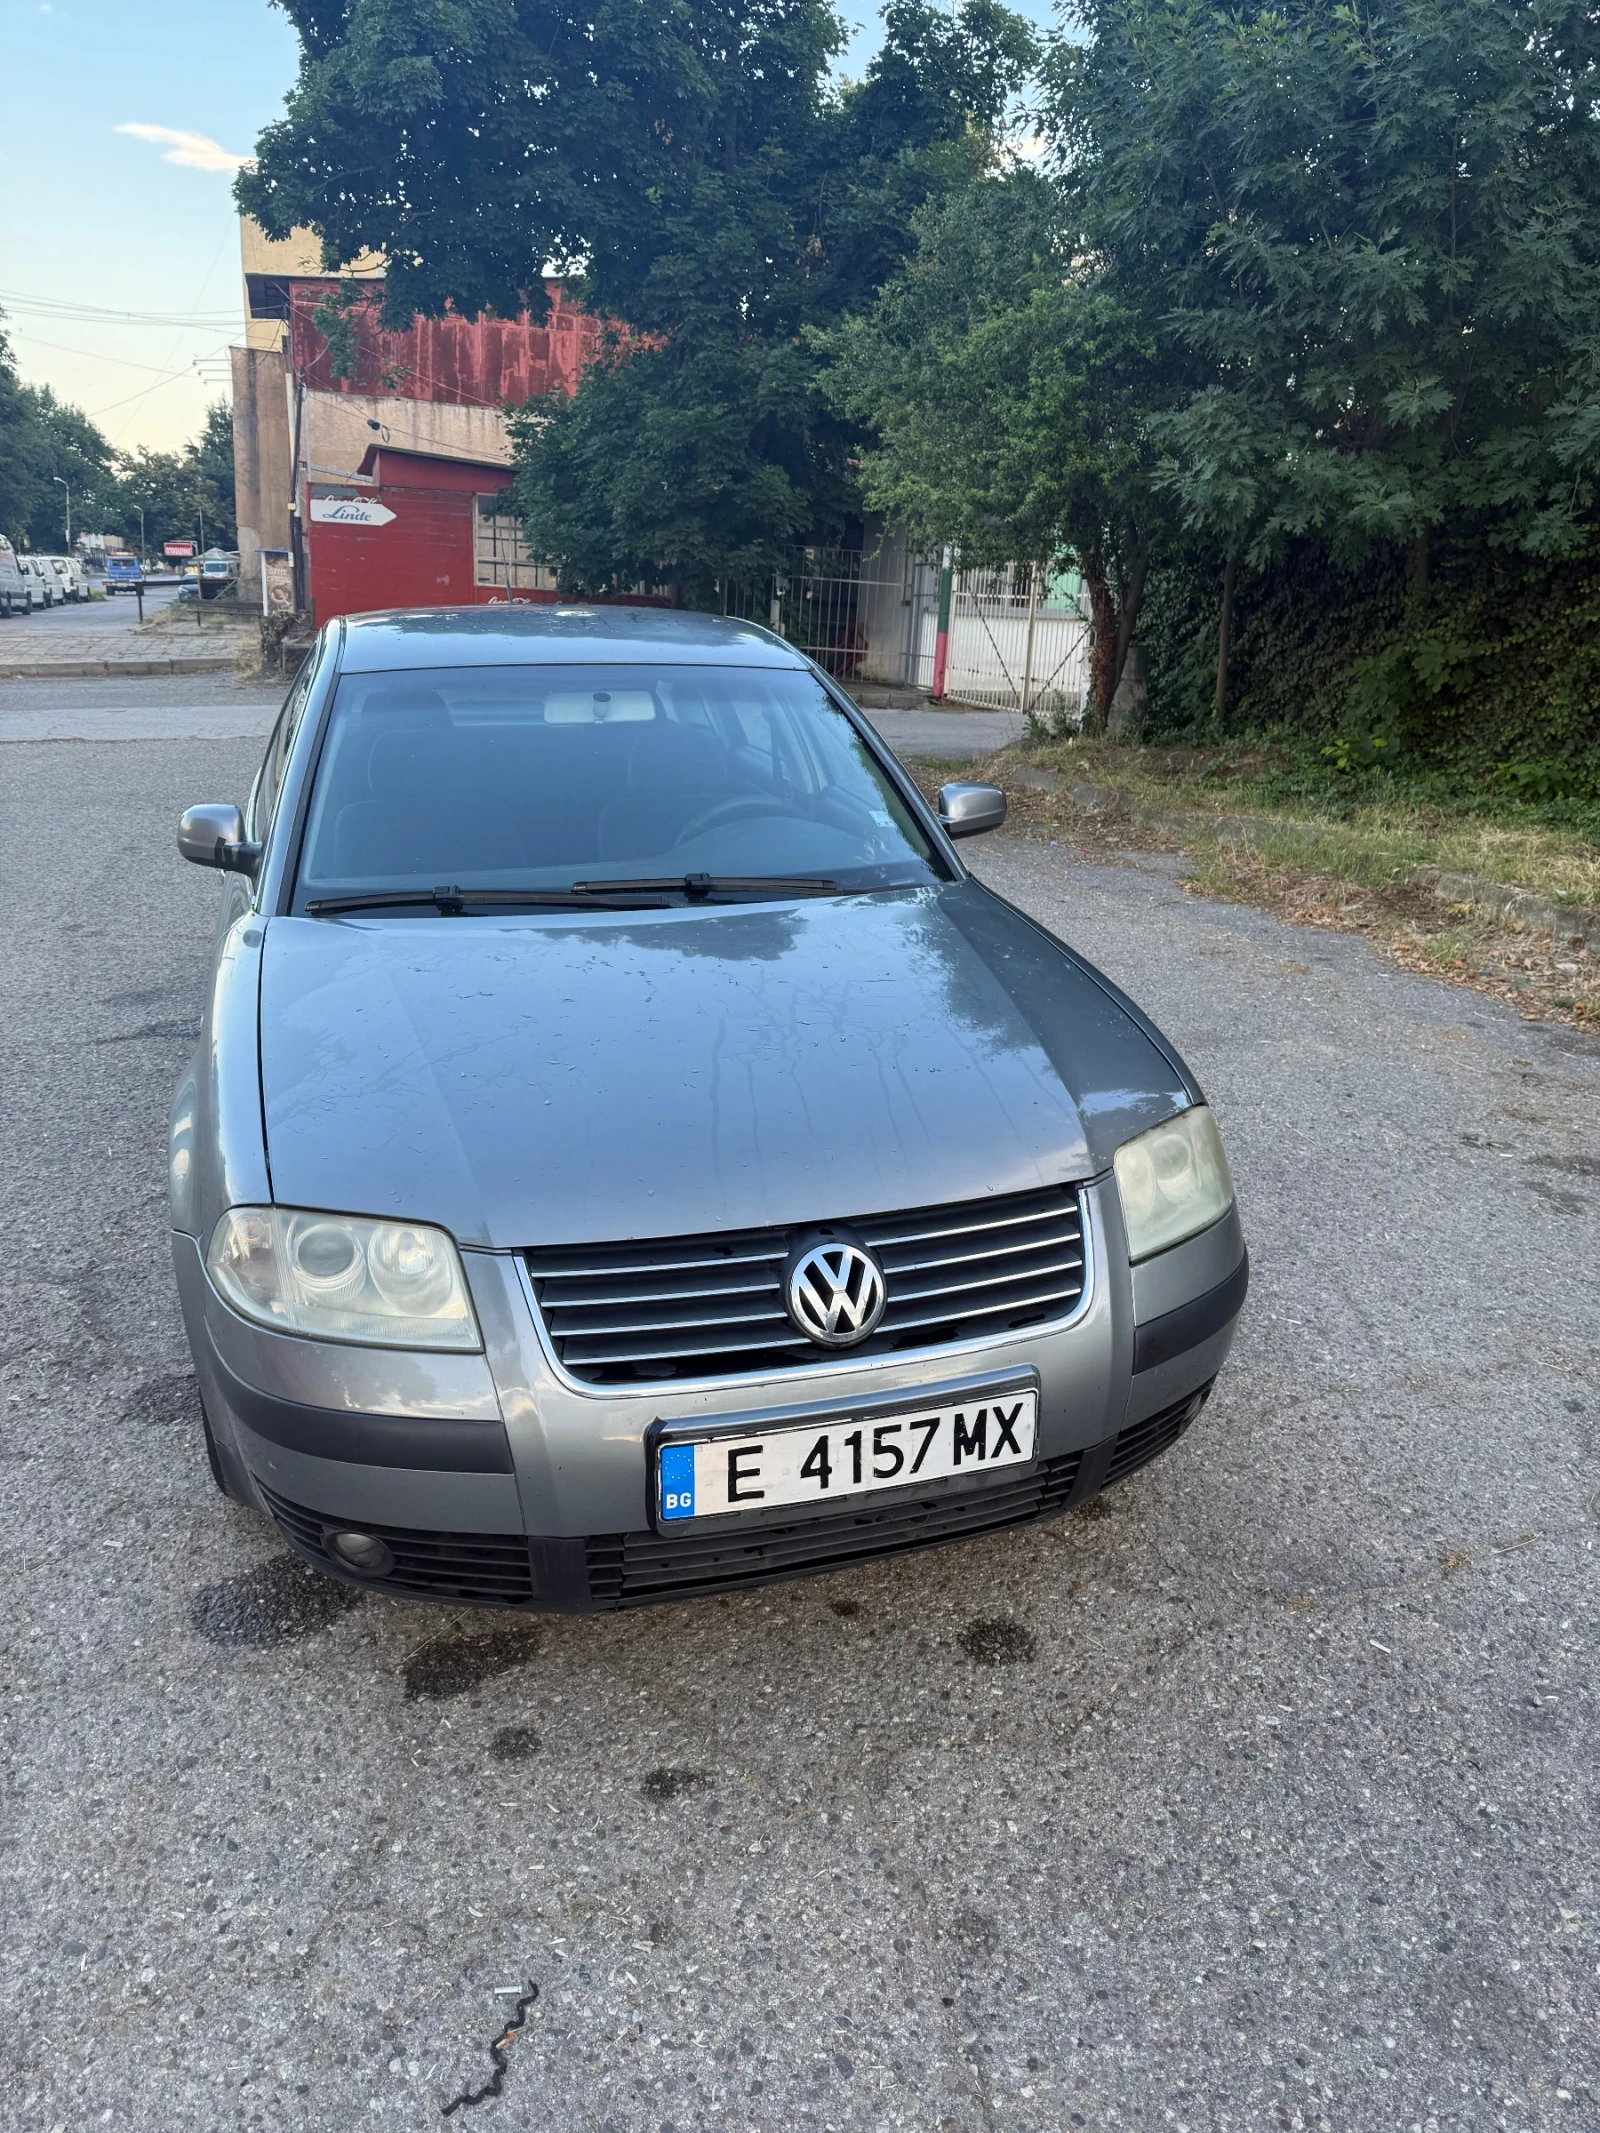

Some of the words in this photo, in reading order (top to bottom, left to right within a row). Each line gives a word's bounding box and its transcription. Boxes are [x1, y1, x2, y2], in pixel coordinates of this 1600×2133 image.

[322, 505, 371, 521] Linde
[791, 1243, 884, 1342] VW
[728, 1445, 765, 1503] E
[800, 1417, 941, 1489] 4157
[953, 1402, 1024, 1466] MX
[666, 1492, 692, 1509] BG
